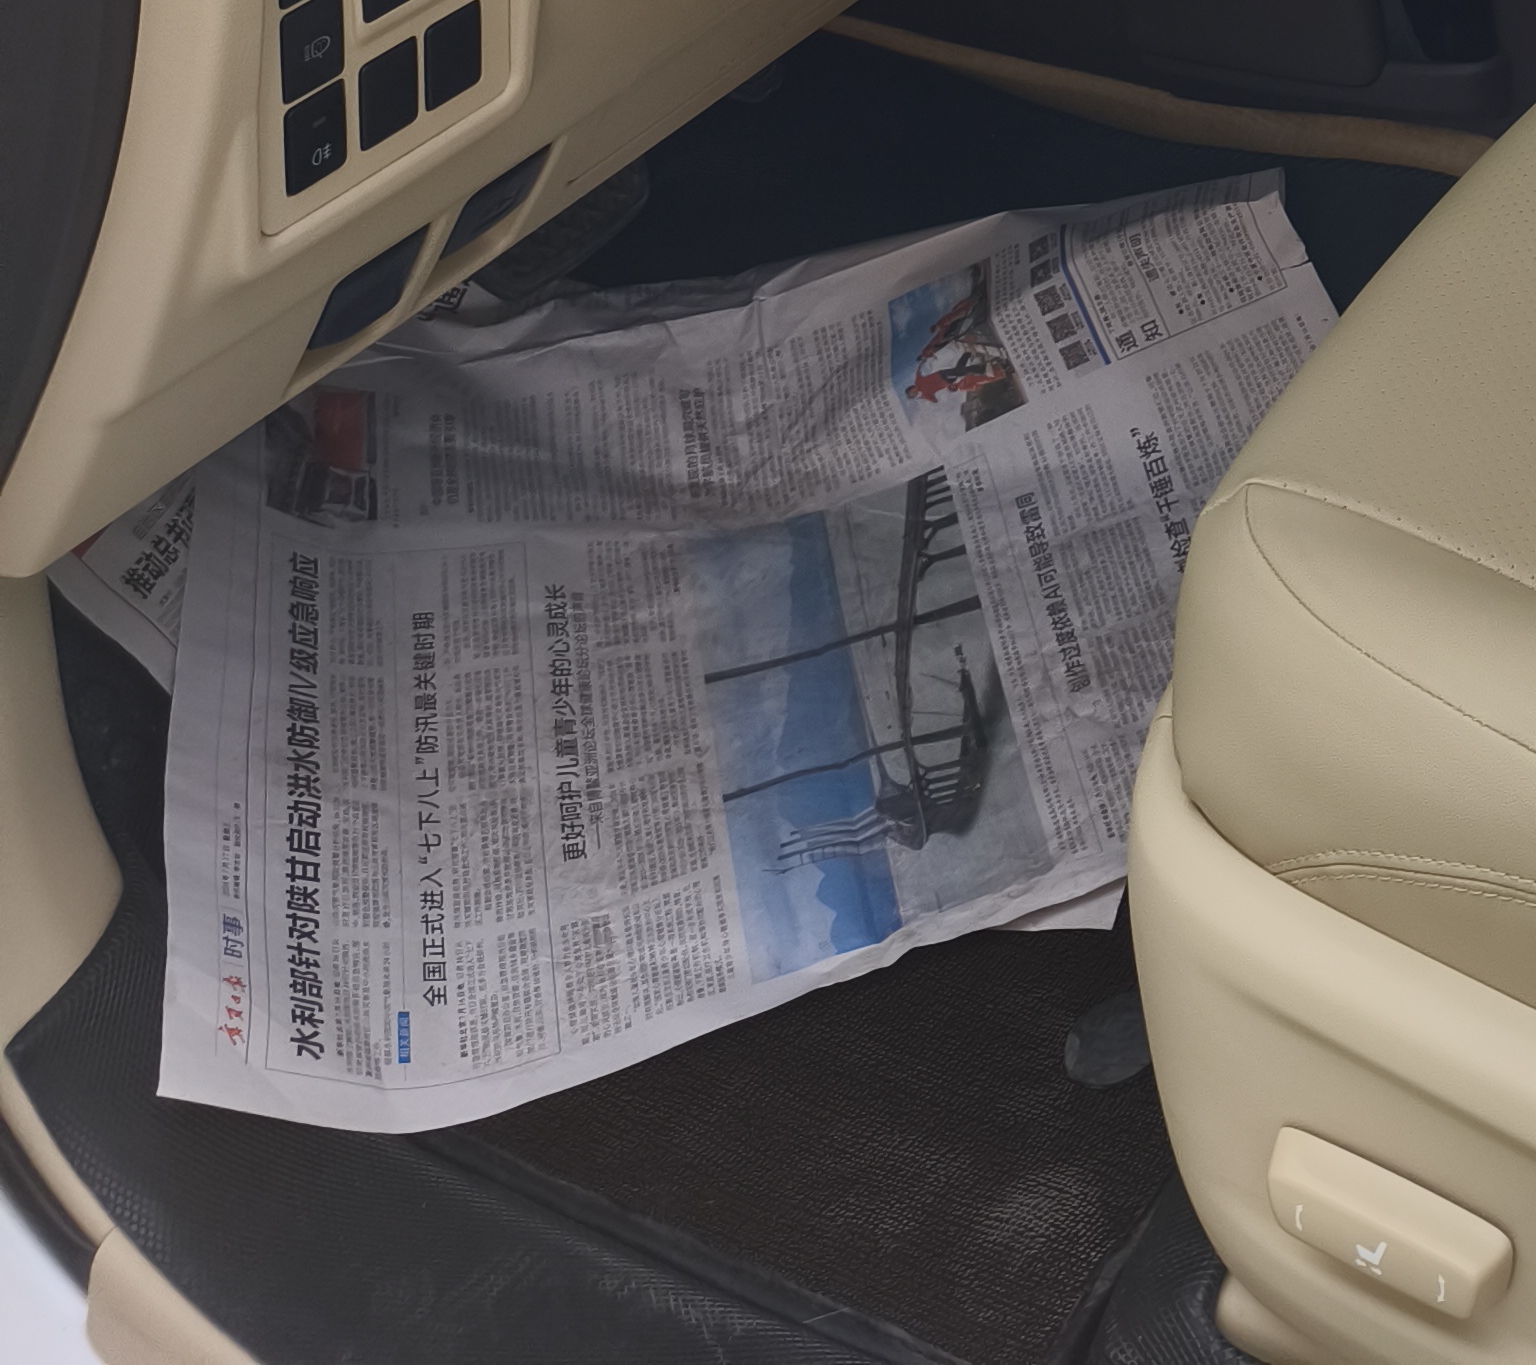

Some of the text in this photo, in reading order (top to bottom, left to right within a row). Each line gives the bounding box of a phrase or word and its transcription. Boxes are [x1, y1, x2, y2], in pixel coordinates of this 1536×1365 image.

[1014, 490, 1093, 693] 创作过度依赖AI可能导致雷同
[544, 582, 589, 863] 更好呵护儿童青少年的心灵成长
[221, 913, 246, 960] 时事
